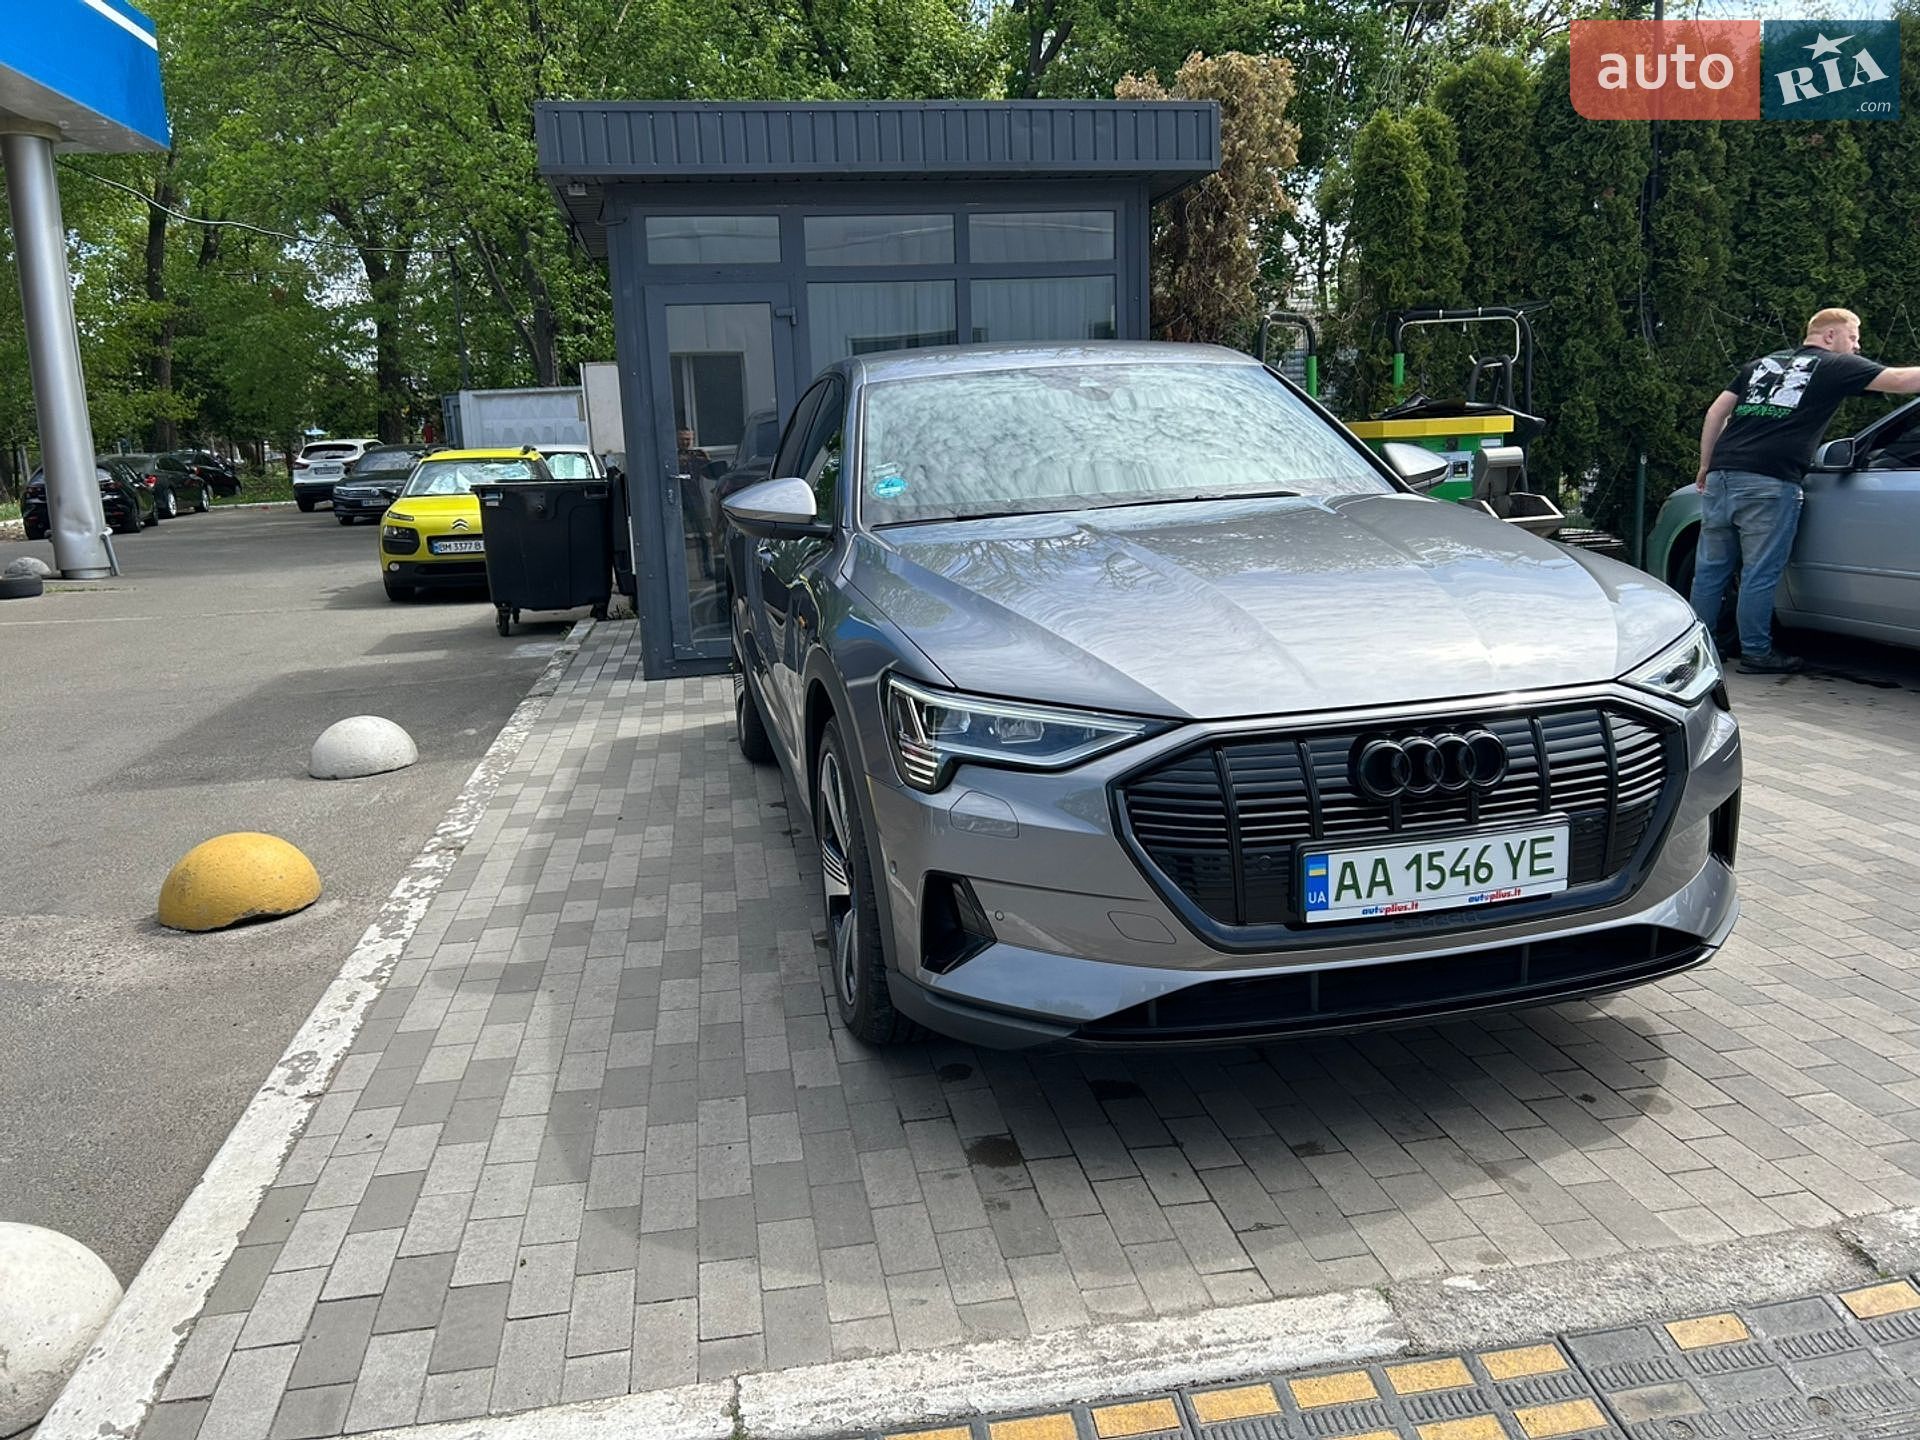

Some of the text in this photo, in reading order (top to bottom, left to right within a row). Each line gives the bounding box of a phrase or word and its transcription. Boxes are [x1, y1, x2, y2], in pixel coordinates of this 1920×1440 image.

[1335, 835, 1555, 902] AA 1546 YE
[1308, 891, 1327, 904] UA
